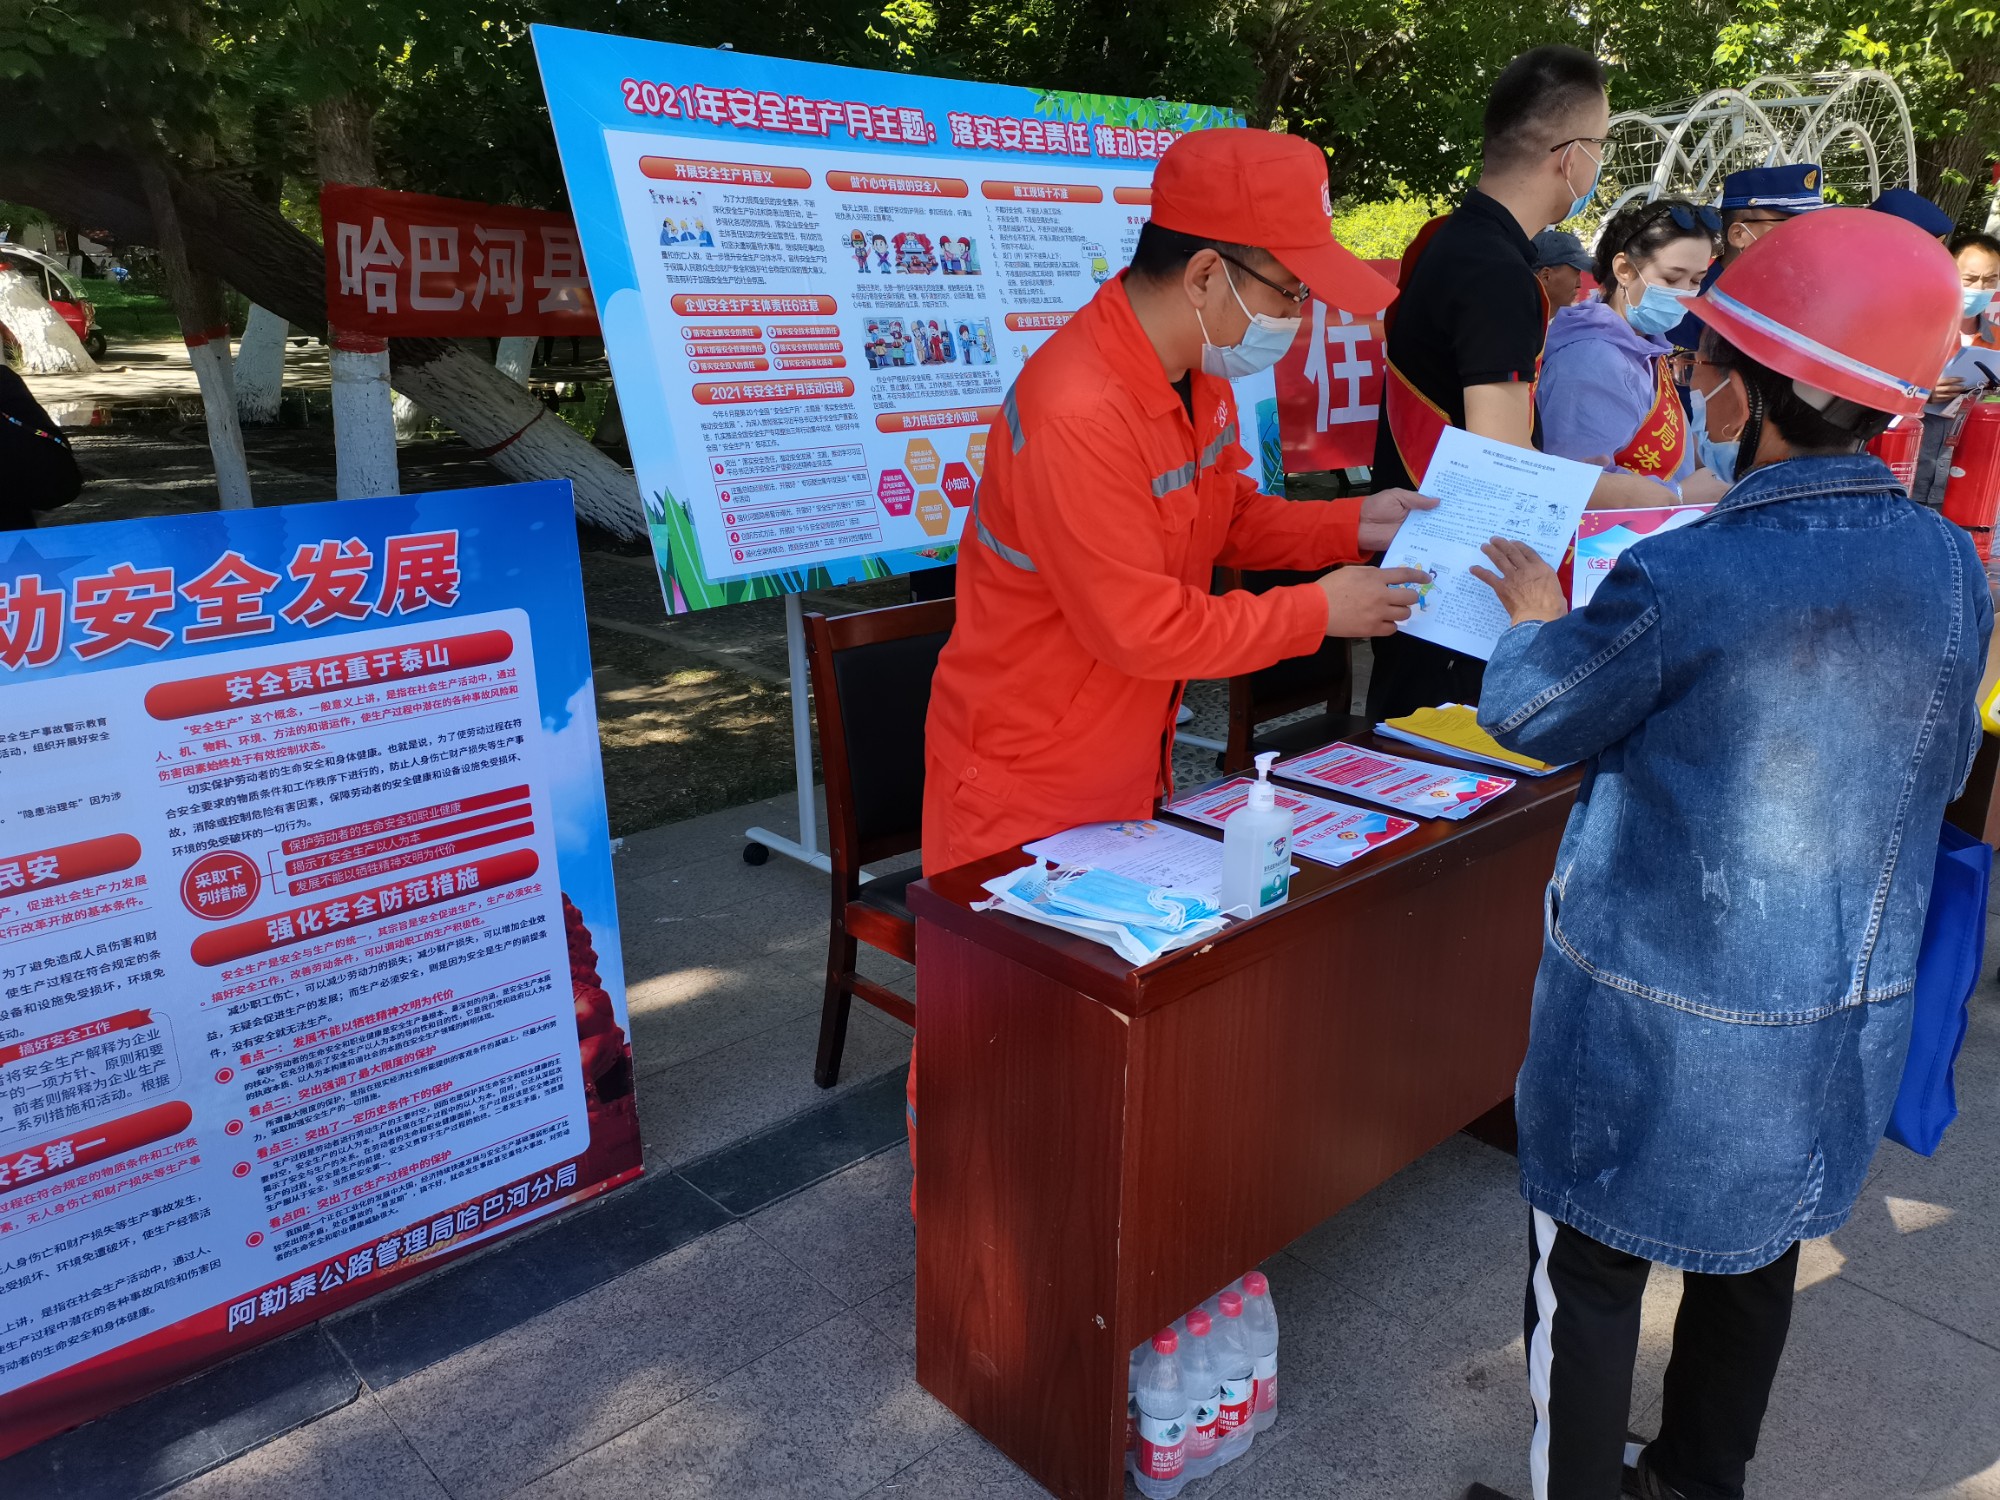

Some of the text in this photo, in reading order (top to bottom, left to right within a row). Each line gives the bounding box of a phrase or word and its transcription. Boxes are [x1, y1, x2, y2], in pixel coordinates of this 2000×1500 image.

[618, 77, 1183, 159] 2021年安全生产月主题： 落实安全责任 推动安全
[673, 163, 774, 183] 开展安全生产月意义
[849, 175, 941, 193] 做个心中有数的安全人
[1012, 184, 1069, 200] 施工现场十不准
[337, 216, 591, 315] 哈巴河县
[683, 298, 820, 313] 企业安全生产主体责任6注意
[1016, 315, 1074, 328] 企业员工安全知
[1303, 298, 1388, 433] 住
[901, 410, 979, 428] 热力供应安全小知识
[944, 476, 970, 491] 小知识
[224, 641, 450, 704] 安全责任重于泰山
[157, 738, 328, 783] 伤害因素始终处于有效控制状态。
[170, 814, 314, 858] 环境的免受破坏的一切行为。
[288, 801, 462, 853] 保护劳动者的生命安全和职业健康
[0, 851, 62, 892] 民安
[193, 864, 244, 890] 采取下
[291, 831, 421, 874] 揭示了安全生产以人为本
[294, 841, 456, 894] 发展不能以牺牲精神文明为代价
[196, 881, 248, 908] 列措施
[265, 864, 480, 944] 强化安全防范措施
[1, 929, 158, 980] 为了避免造成人员伤害和财
[3, 948, 161, 1000] 使生产过程在符合规定的条
[17, 1019, 111, 1057] 搞好安全工作
[208, 1010, 333, 1060] 件，没有安全就无法生产。
[247, 1043, 437, 1118] 看点二：突出强调了最大限度的保护
[255, 1079, 454, 1160] 看点三：突出了一定历史条件下的保护
[268, 1148, 452, 1229] 看点四：突出了在生产过程中的保护
[0, 1191, 202, 1275] 人身伤亡和财产损失等生产事故发生，
[224, 1161, 578, 1333] 阿勒泰公路管理局哈巴河分局
[0, 1242, 213, 1336] 上讲，是指在社会生产活动中，通过人、
[1152, 1447, 1185, 1461] 农夫山
